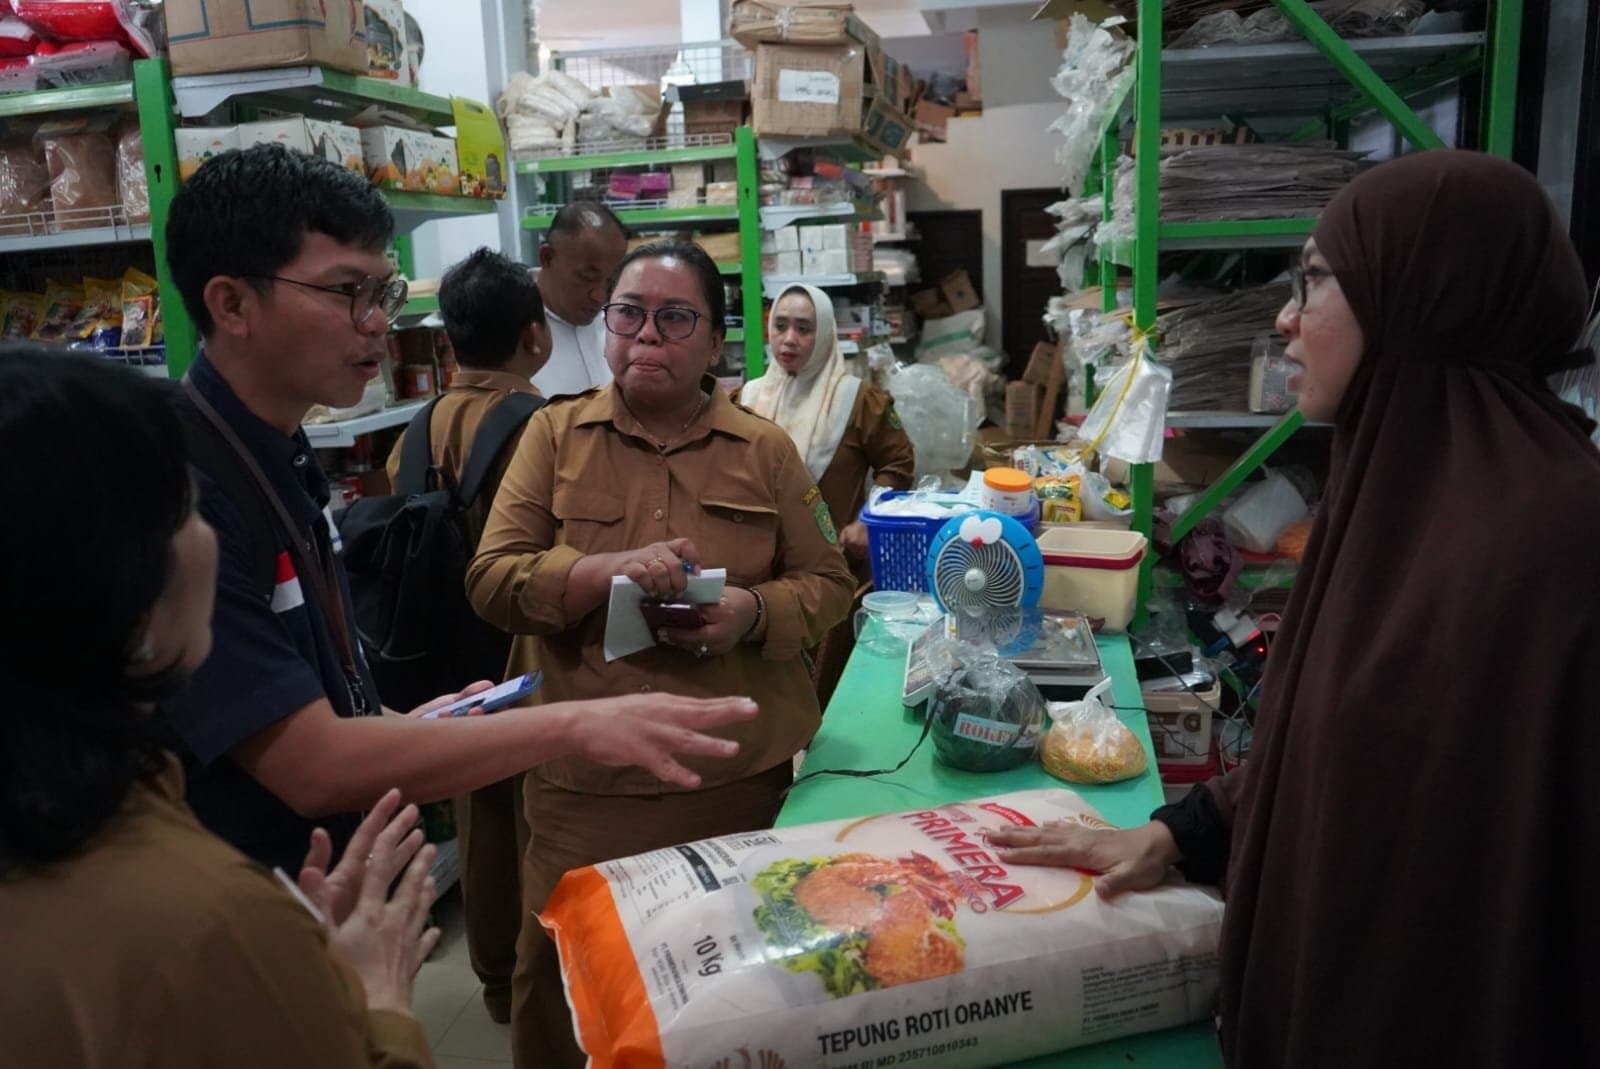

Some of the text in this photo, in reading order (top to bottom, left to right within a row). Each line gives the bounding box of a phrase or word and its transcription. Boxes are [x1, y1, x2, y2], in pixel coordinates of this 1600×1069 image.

[899, 810, 1025, 911] PRIMERA
[693, 935, 724, 977] 10 Kg
[818, 991, 1033, 1056] TEPUNG ROTI ORANYE
[877, 1055, 896, 1067] MD
